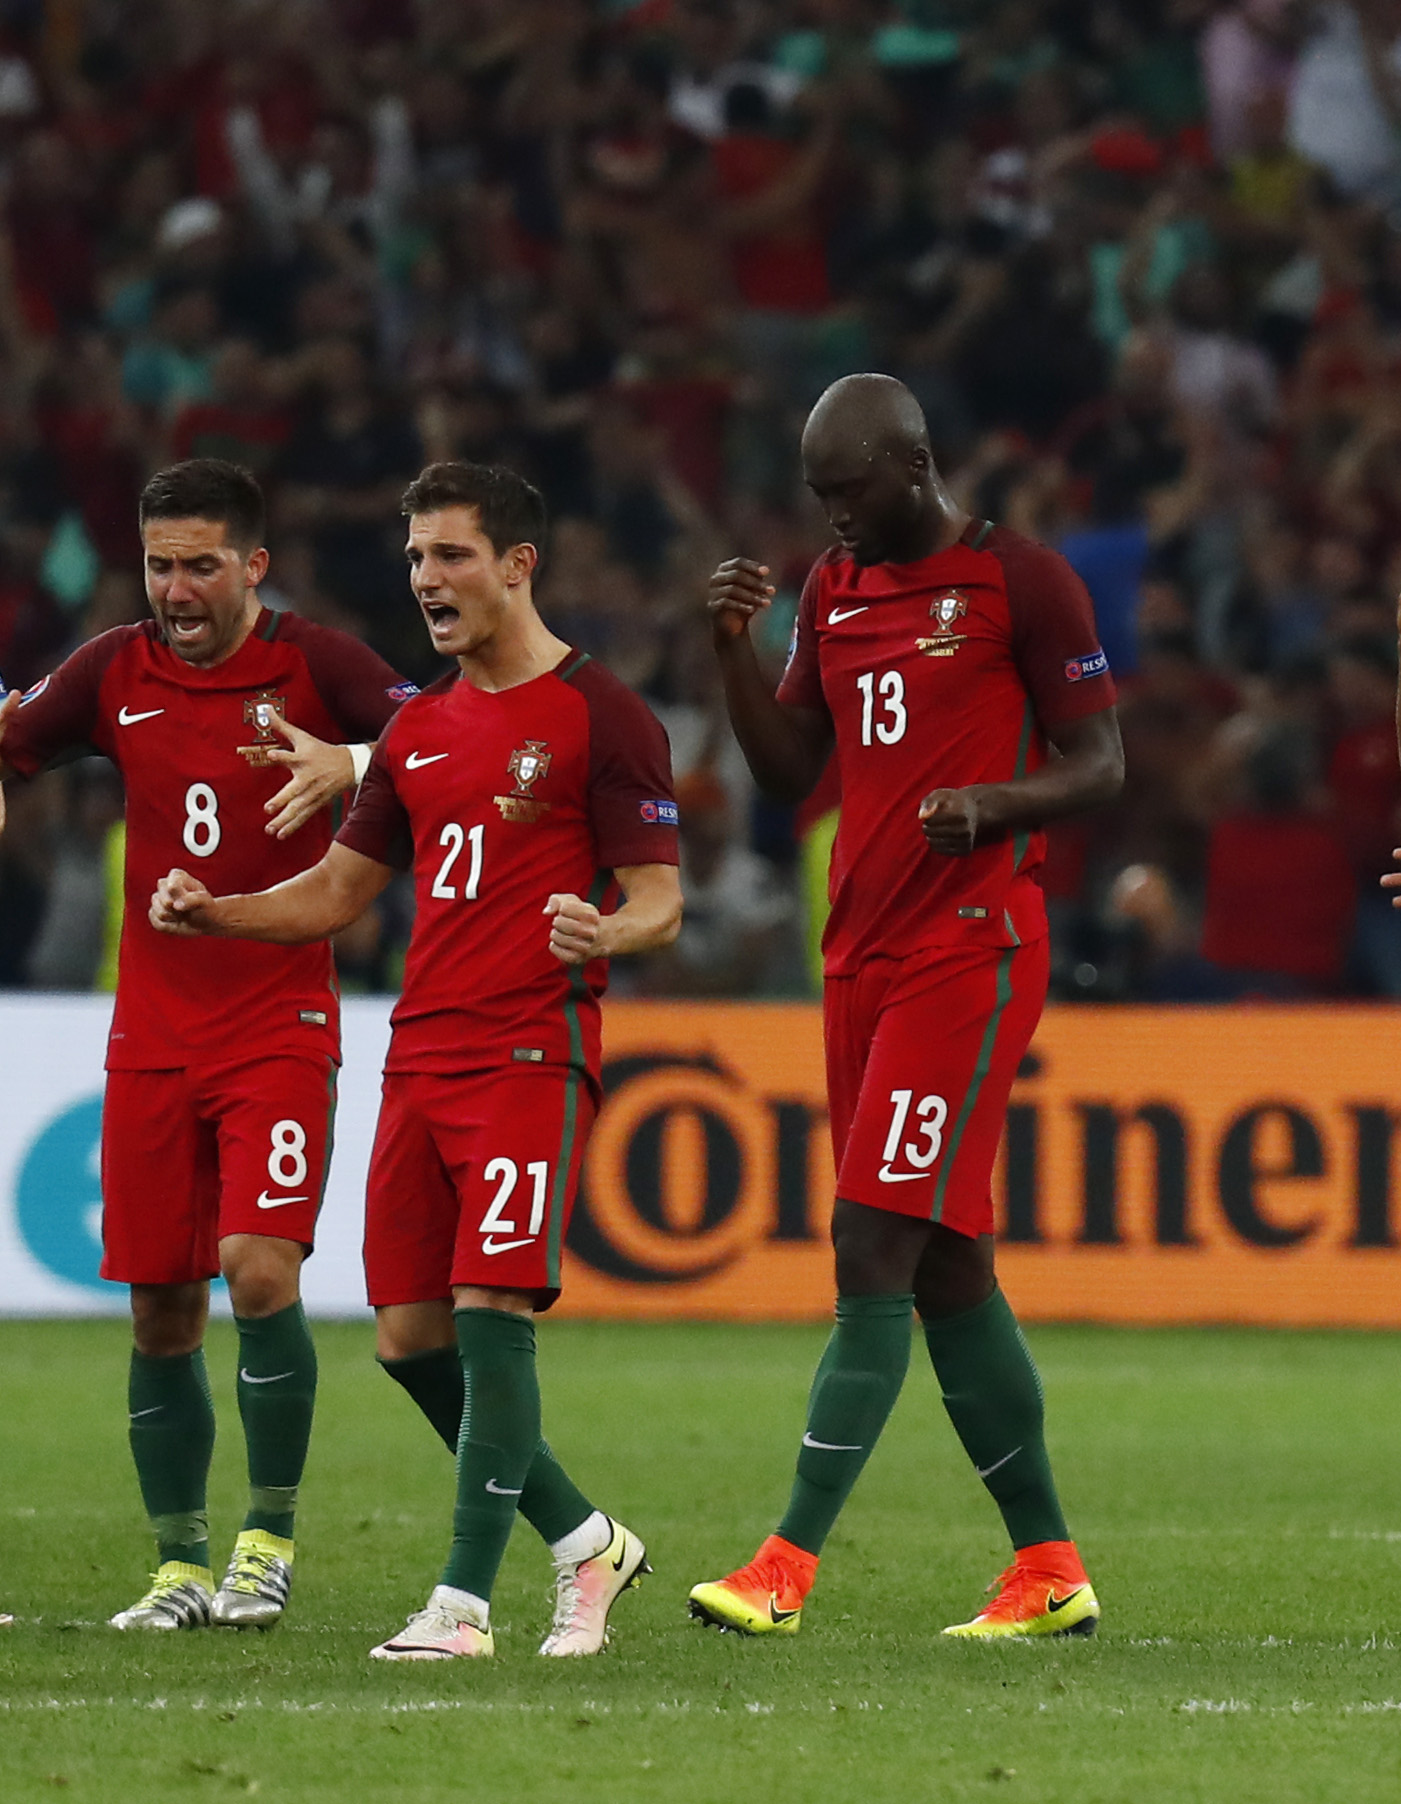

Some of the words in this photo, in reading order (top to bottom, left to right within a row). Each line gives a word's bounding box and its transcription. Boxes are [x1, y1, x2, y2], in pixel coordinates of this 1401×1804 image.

[857, 670, 908, 747] 13
[183, 782, 221, 857] 8
[431, 822, 484, 900] 21
[267, 1119, 307, 1188] 8
[882, 1089, 948, 1170] 13
[478, 1157, 548, 1235] 21
